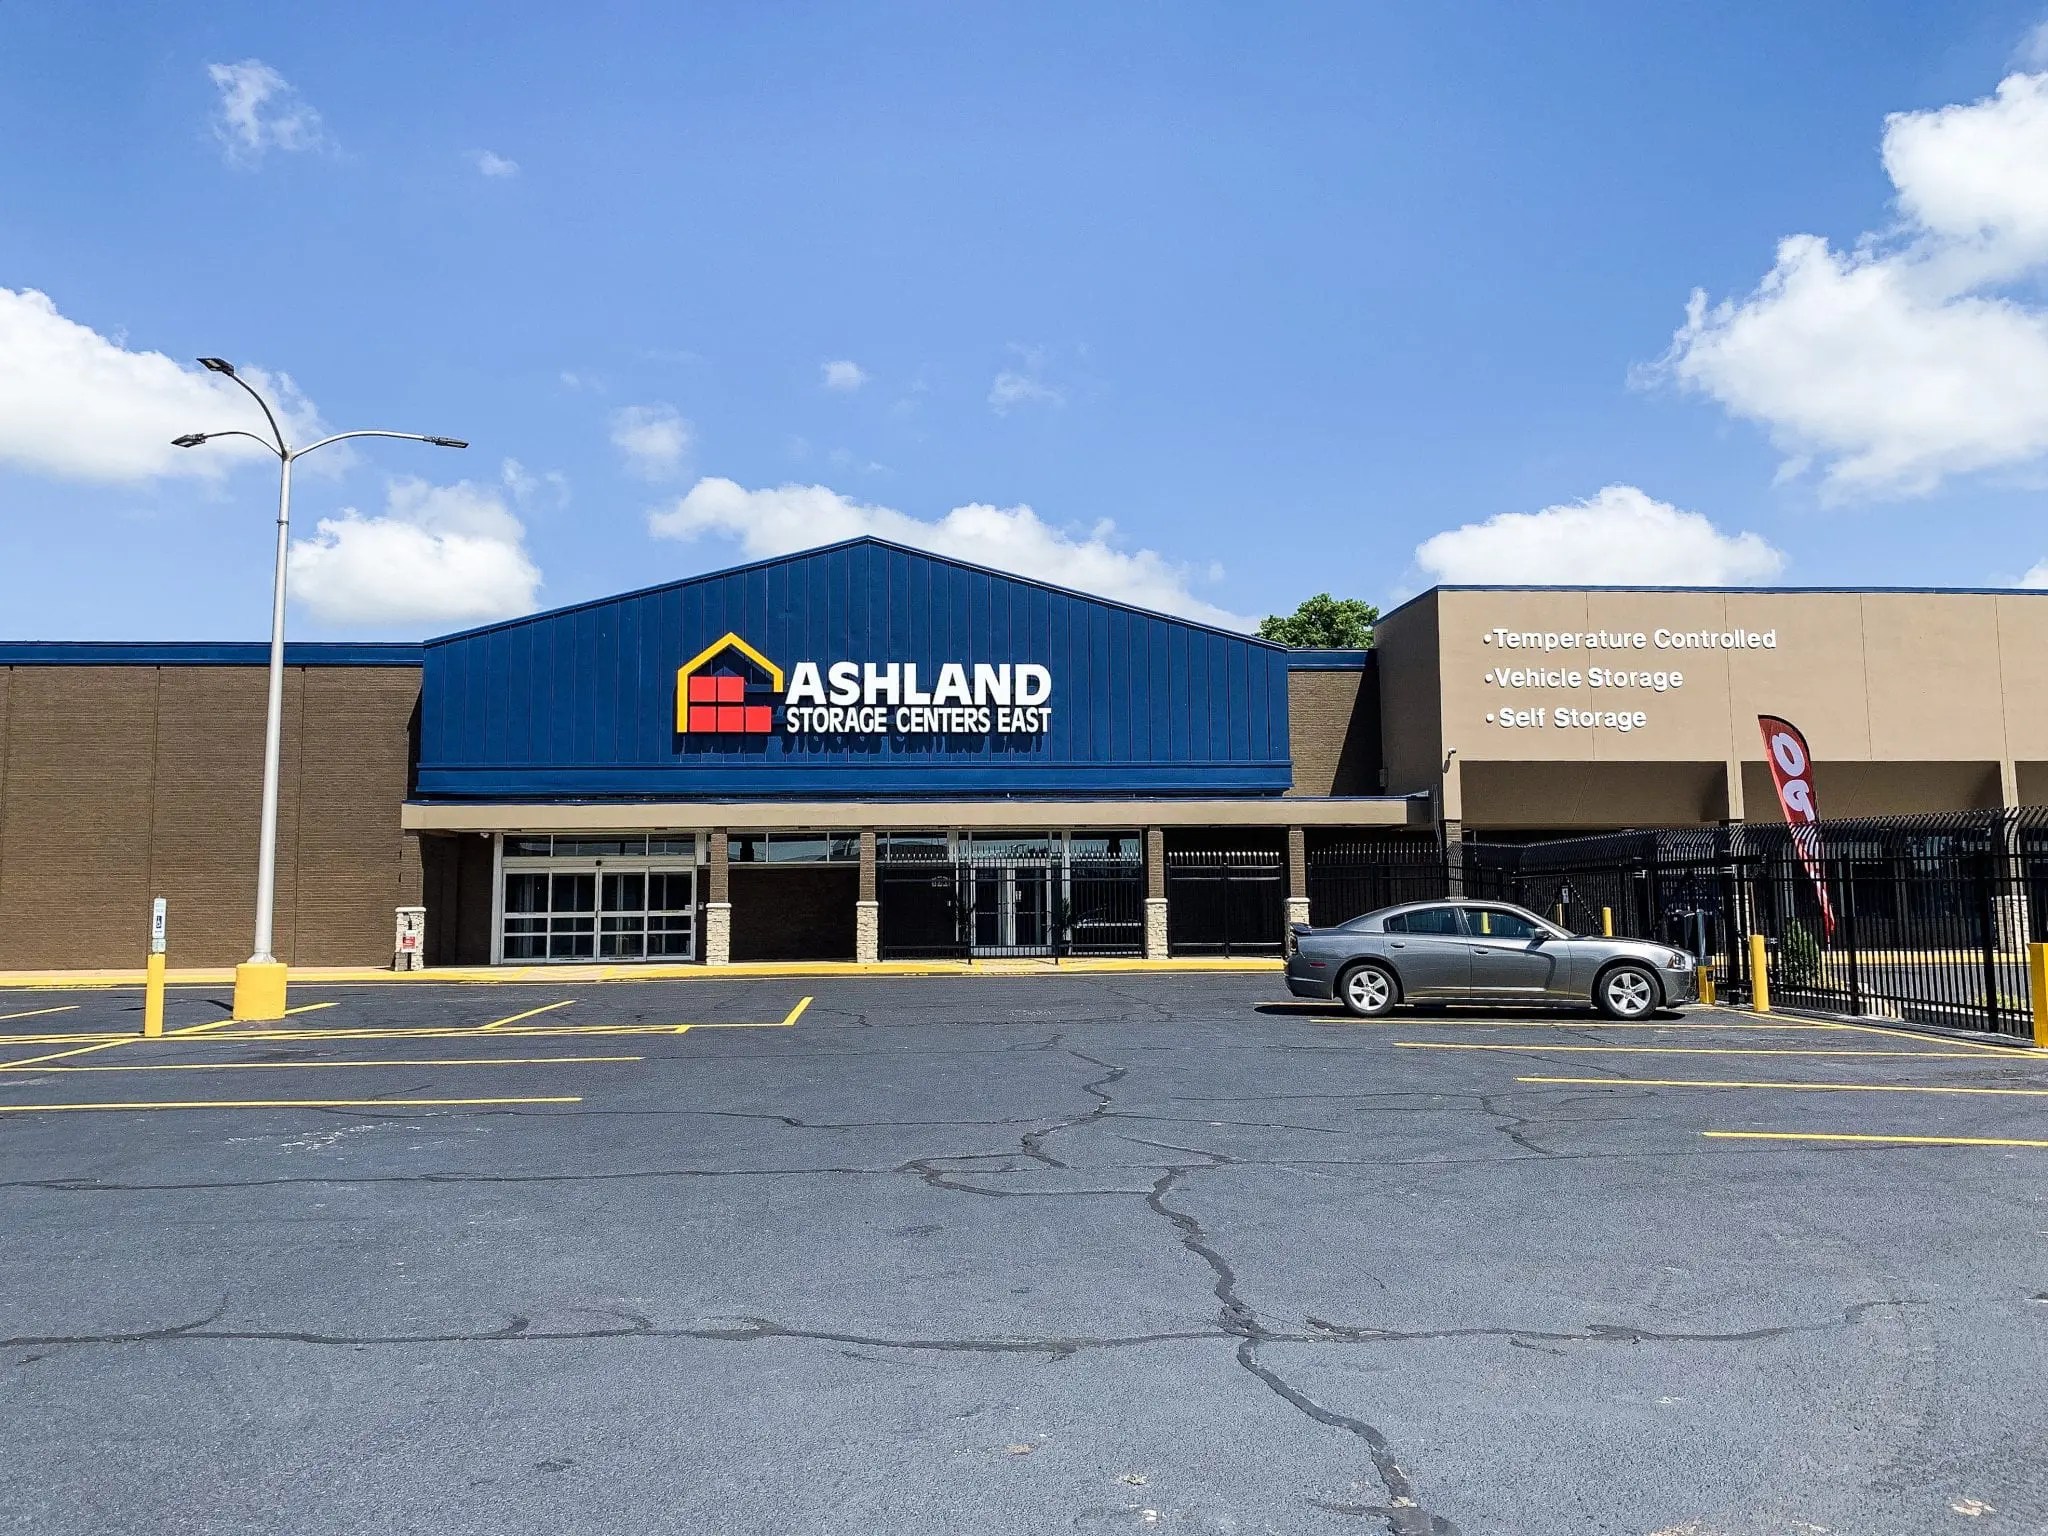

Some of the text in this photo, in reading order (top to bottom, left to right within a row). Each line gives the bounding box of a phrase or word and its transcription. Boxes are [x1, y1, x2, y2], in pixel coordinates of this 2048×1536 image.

[1493, 628, 1777, 652] Temperature Controlled
[785, 661, 1052, 705] ASHLAND
[1494, 667, 1684, 691] Vehicle Storage
[786, 706, 1052, 733] STORAGE CENTERS EAST
[1499, 707, 1647, 732] Self Storage
